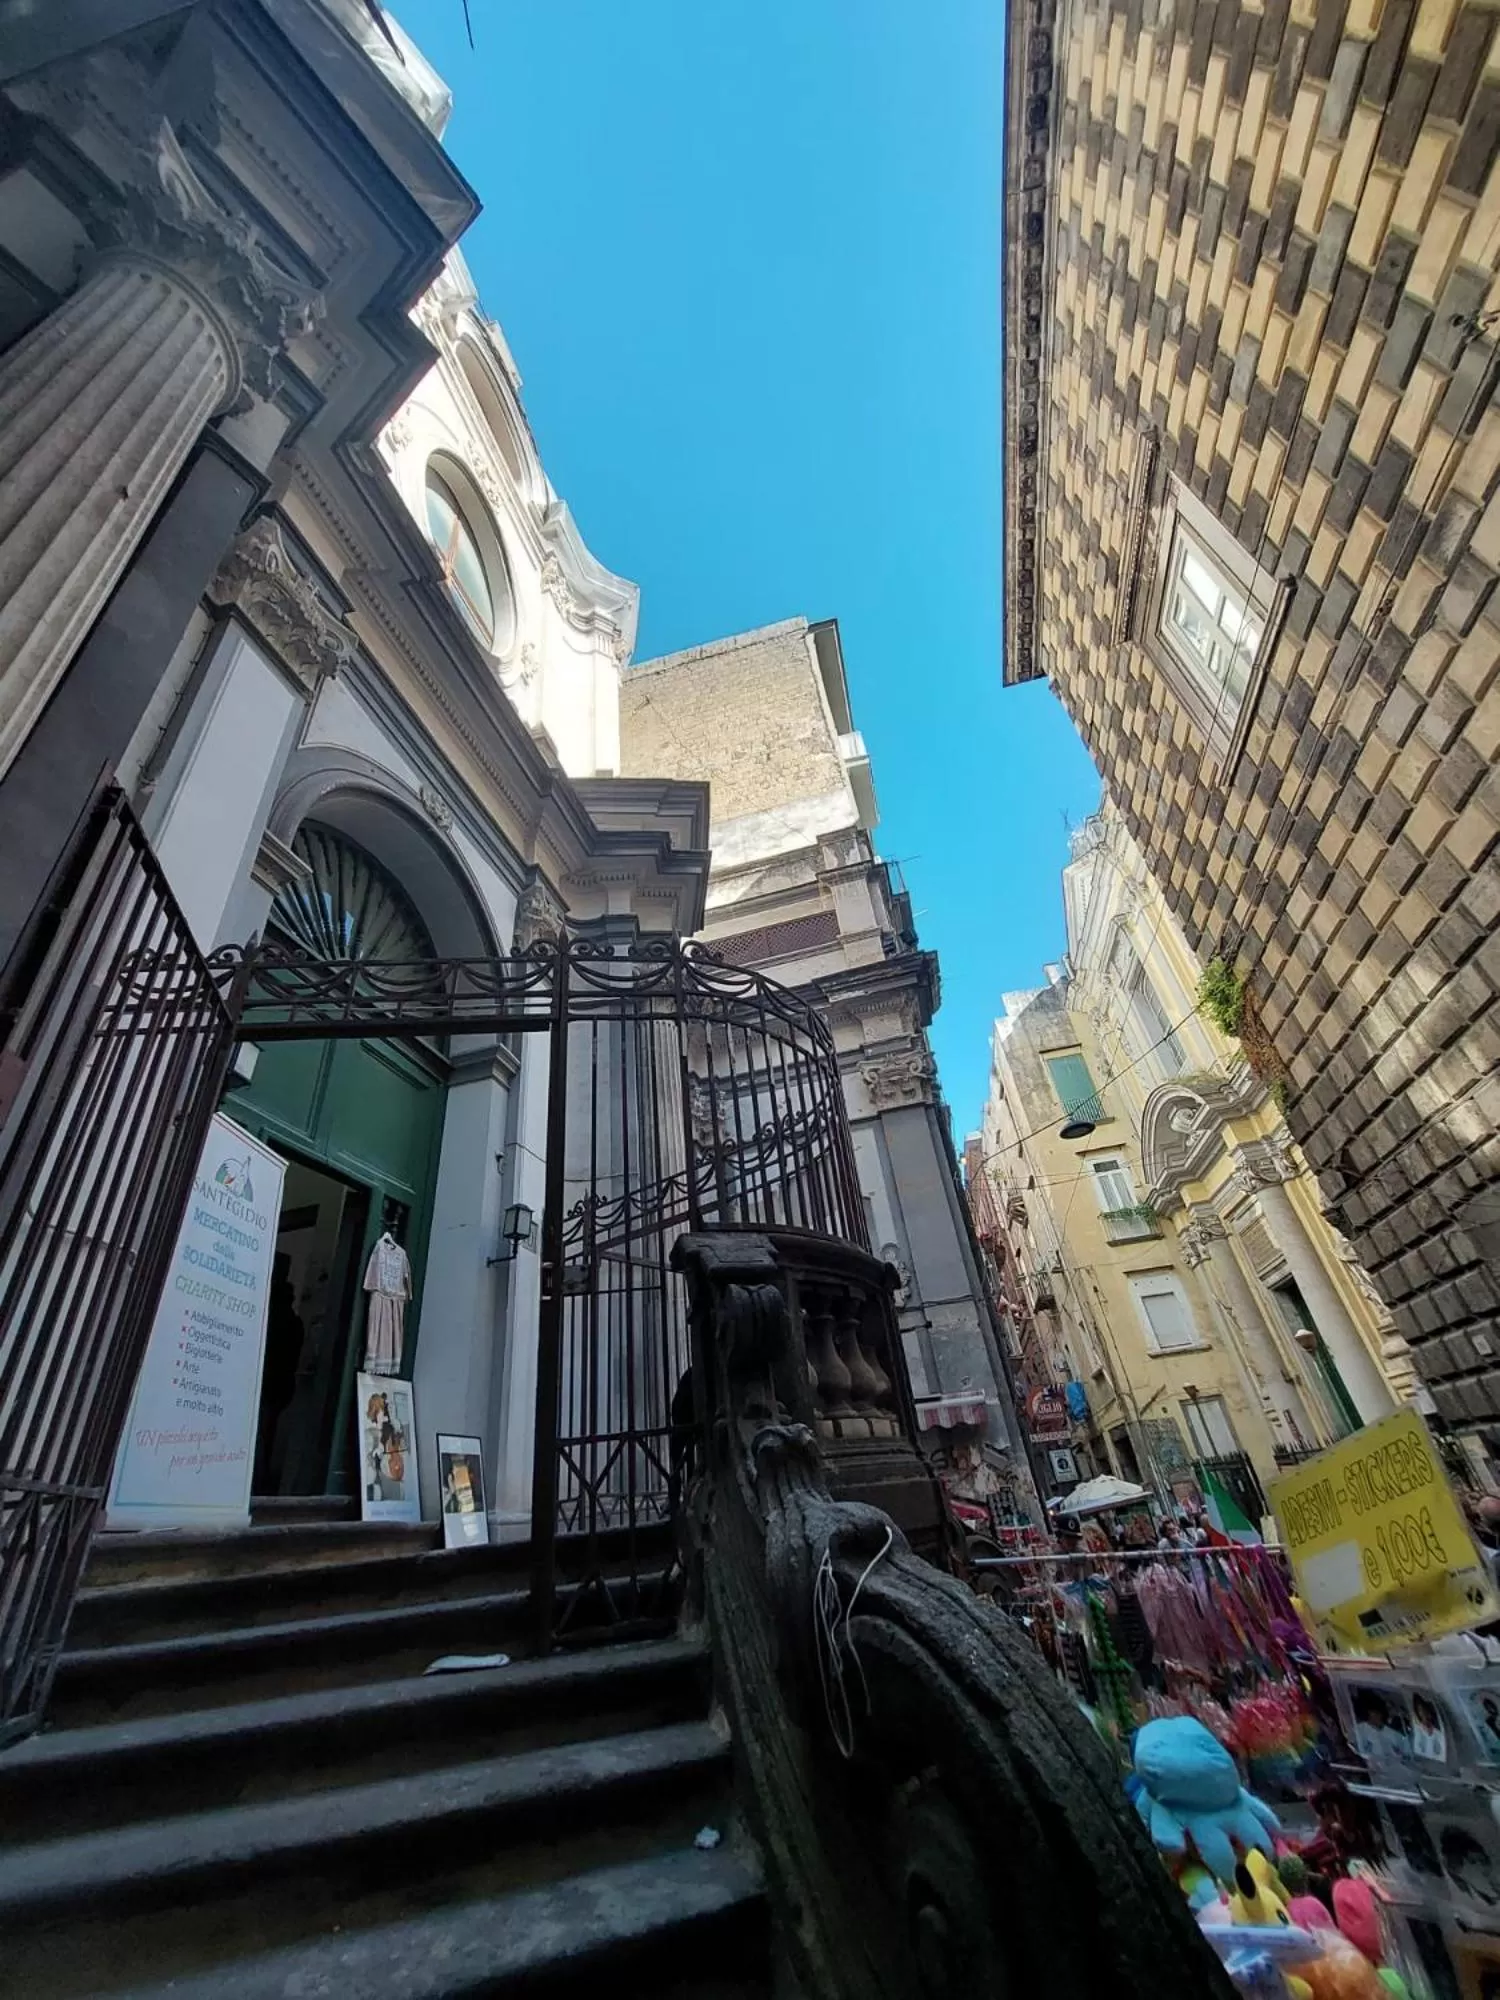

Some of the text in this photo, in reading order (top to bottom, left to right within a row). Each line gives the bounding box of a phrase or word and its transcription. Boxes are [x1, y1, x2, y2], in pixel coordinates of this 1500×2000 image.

[194, 1207, 259, 1252] MERCATINO
[176, 1275, 257, 1318] CHARITY SHOP
[183, 1360, 200, 1374] Arte
